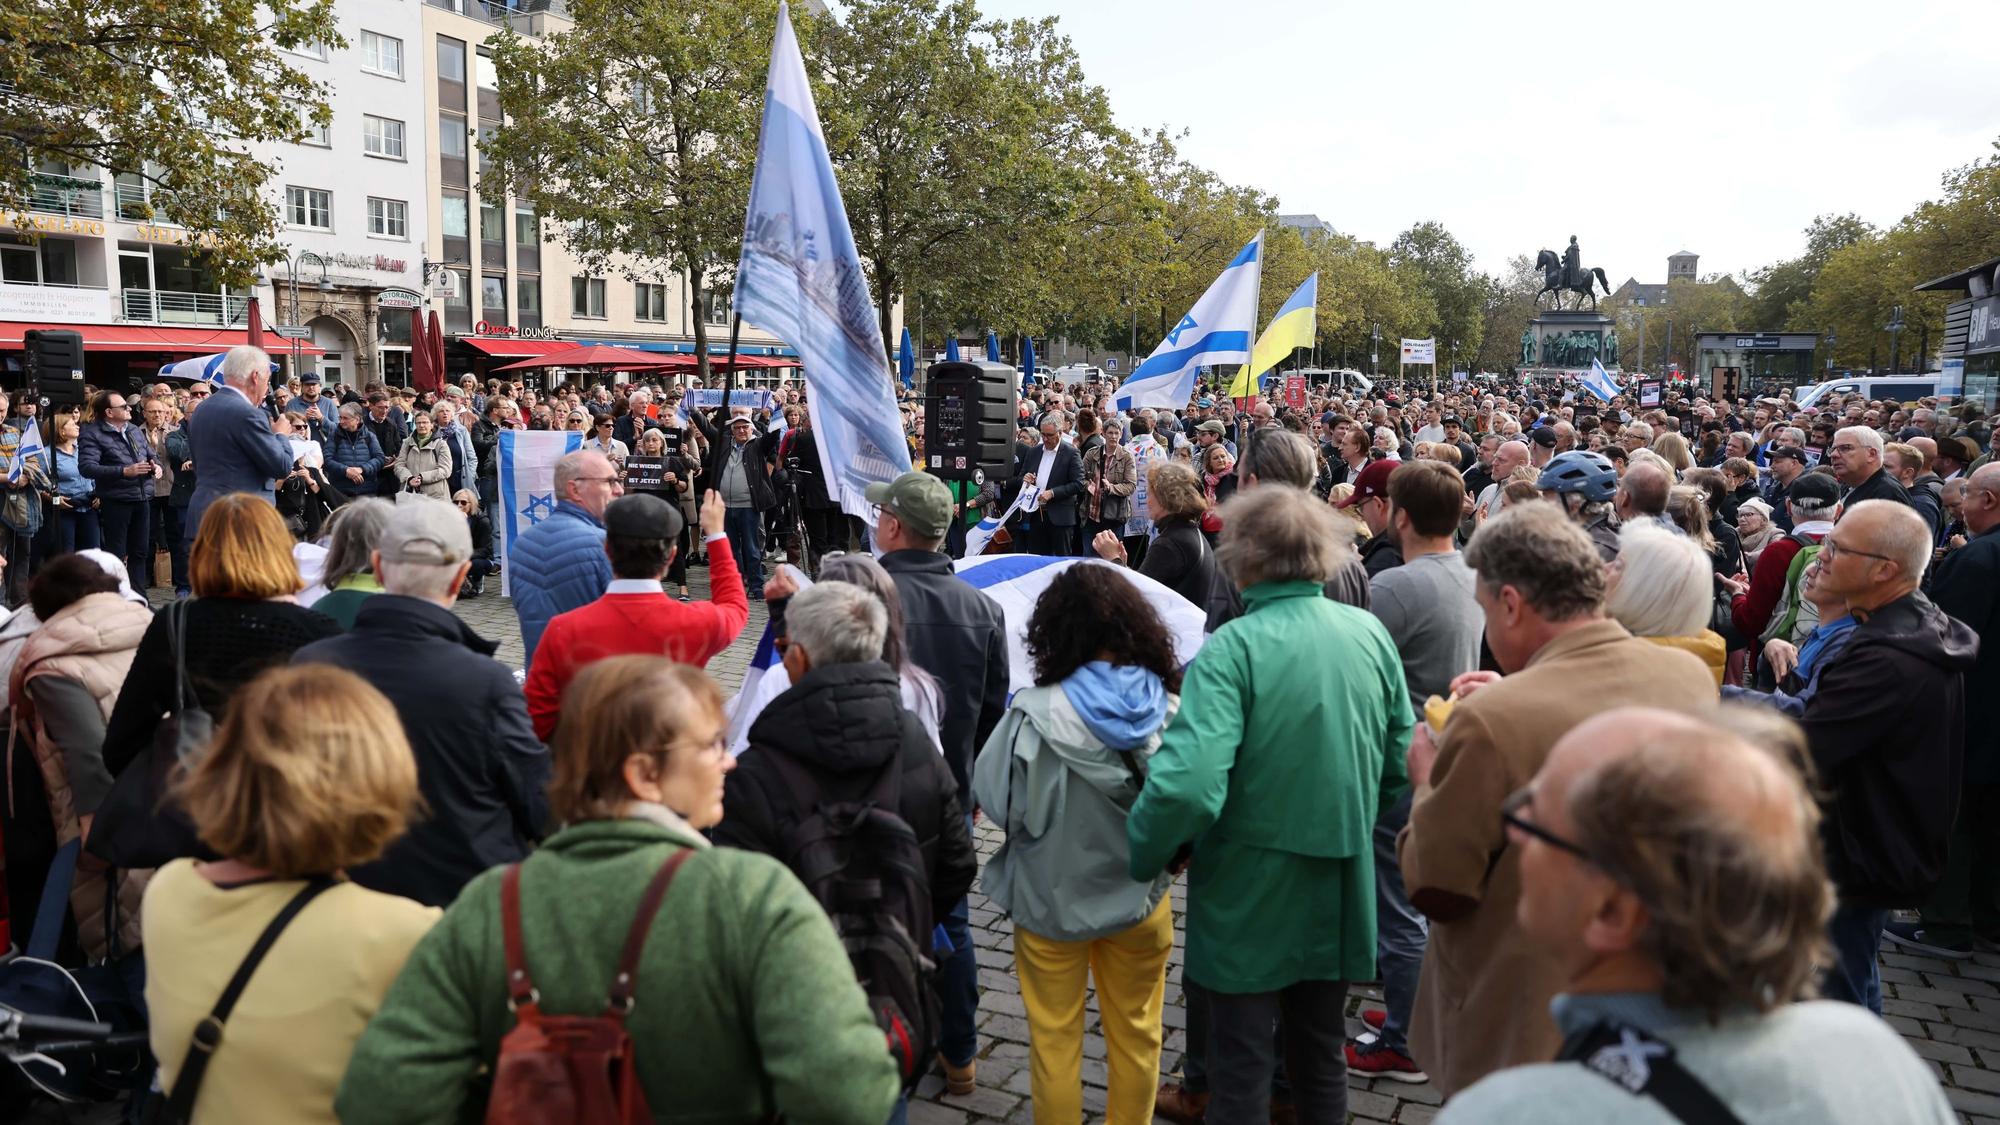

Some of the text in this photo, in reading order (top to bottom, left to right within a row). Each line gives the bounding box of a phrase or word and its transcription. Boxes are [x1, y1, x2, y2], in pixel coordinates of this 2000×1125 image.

[34, 215, 105, 235] GELATO
[375, 253, 408, 273] MILANO
[520, 326, 556, 339] LOUNGE
[640, 477, 661, 485] JETZT!
